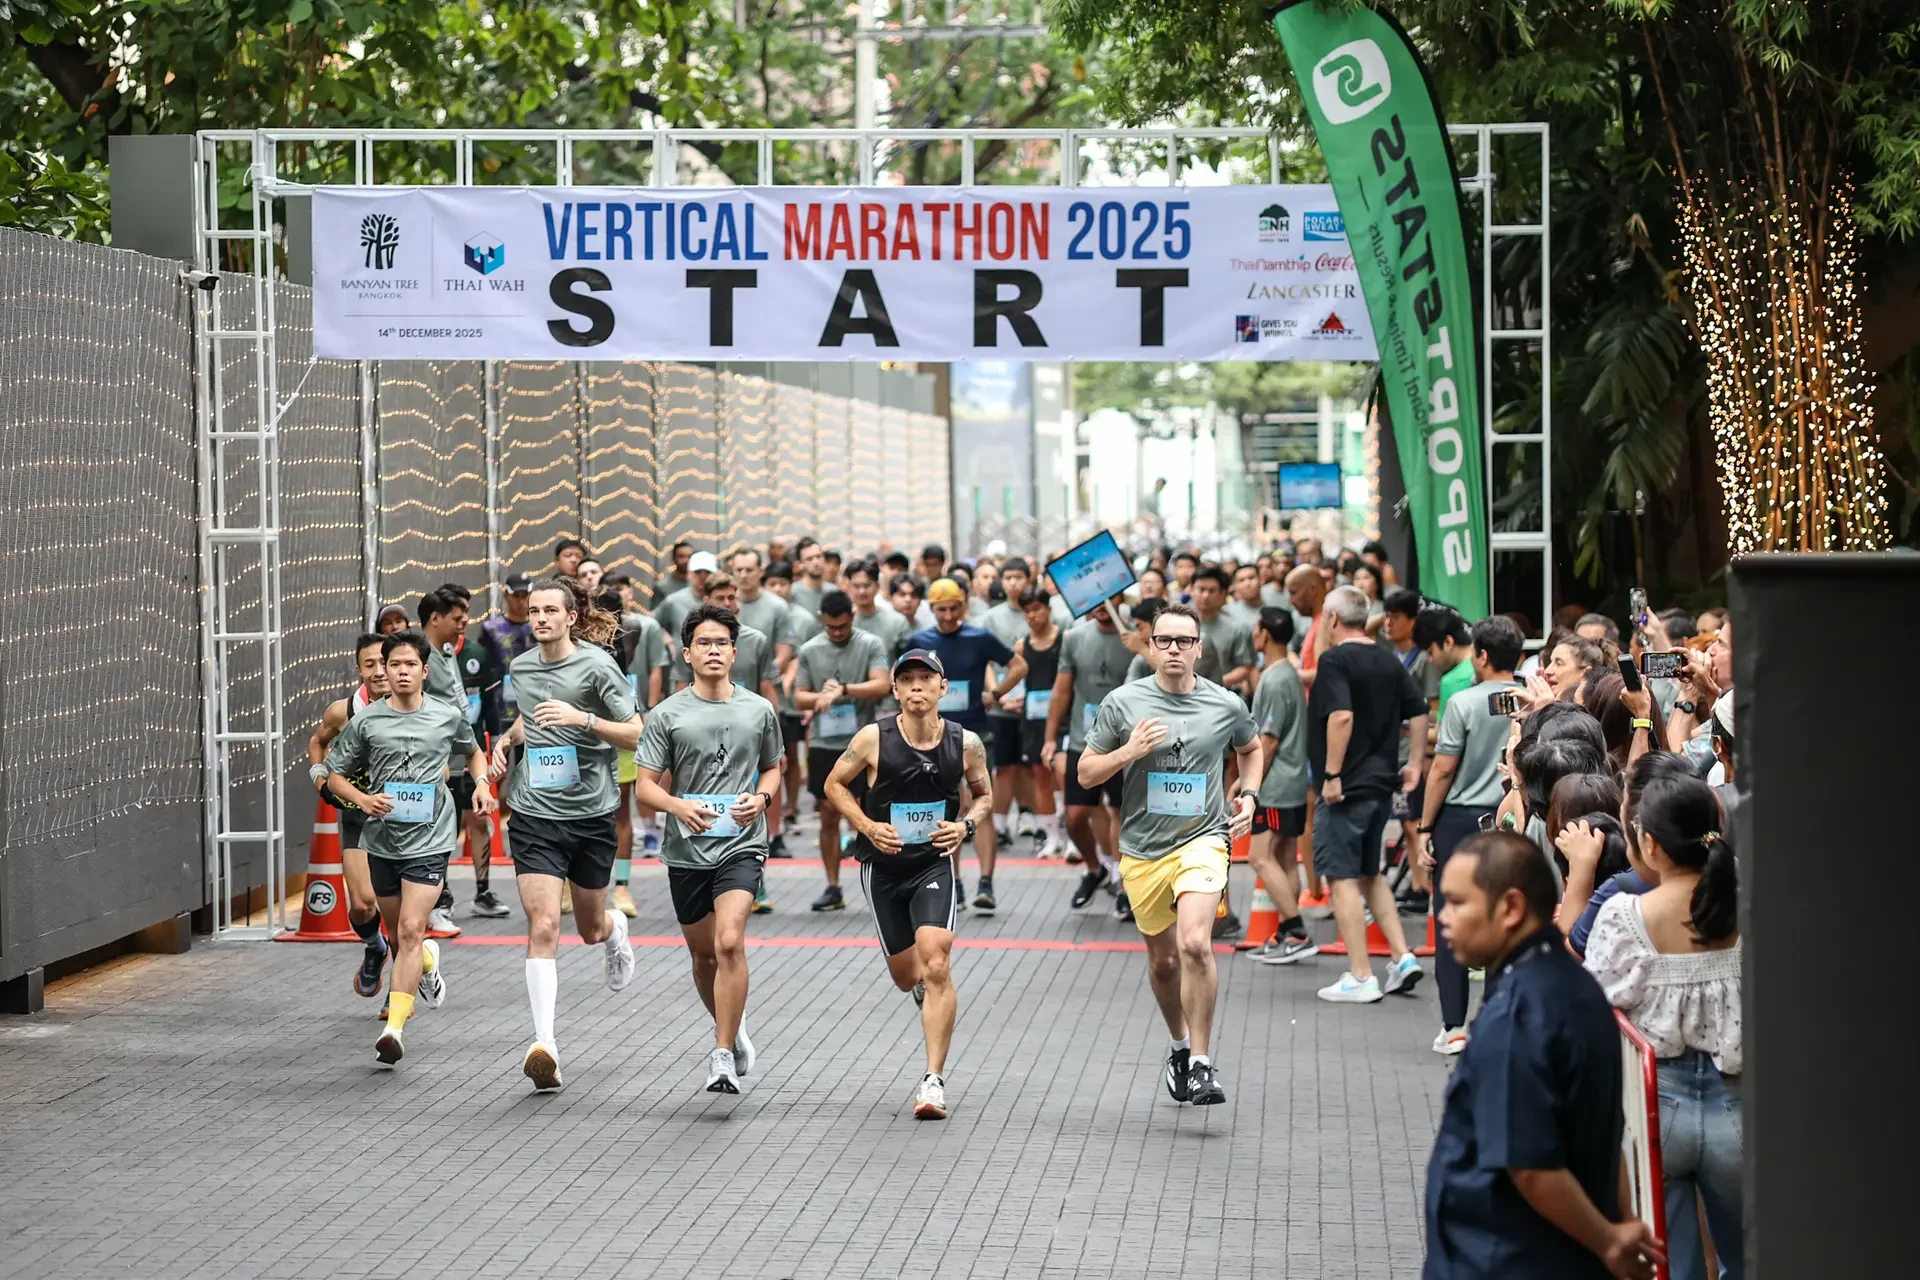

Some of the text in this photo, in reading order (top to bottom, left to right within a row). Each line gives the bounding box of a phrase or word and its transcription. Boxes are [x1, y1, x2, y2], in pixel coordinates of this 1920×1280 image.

[543, 201, 1191, 260] VERTICAL MARATHON 2025
[1304, 223, 1340, 231] SWEAT
[341, 280, 419, 289] BANYAN TREE
[444, 279, 525, 291] THAI WAH
[1247, 281, 1356, 299] LANCASTER
[358, 292, 403, 300] BANGKOK
[547, 267, 1190, 348] START
[1260, 319, 1282, 328] GIVES
[1283, 319, 1298, 328] YOU
[378, 327, 483, 338] 14th DECEMBER 2025
[538, 754, 564, 767] 1023
[1163, 781, 1193, 794] 1070
[396, 790, 424, 802] 1042
[711, 802, 726, 815] 13
[905, 810, 934, 822] 1075
[309, 892, 332, 905] IFS
